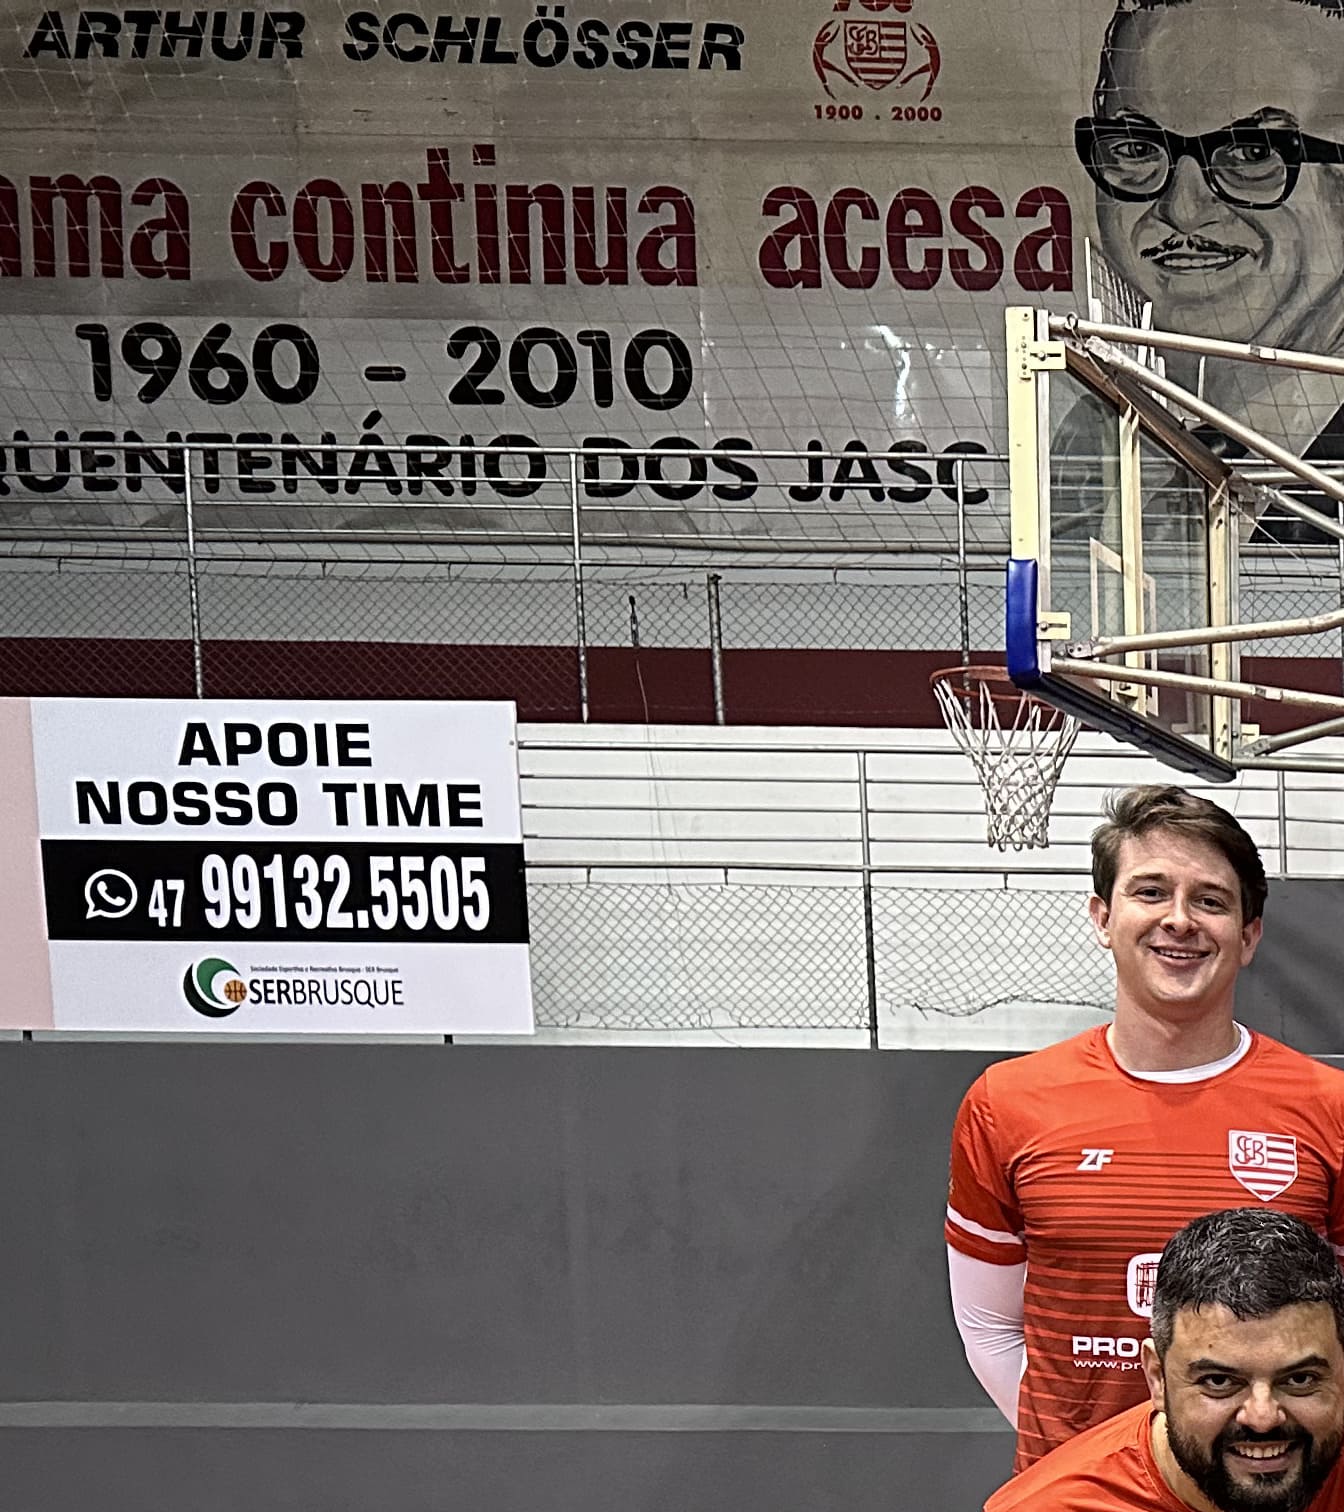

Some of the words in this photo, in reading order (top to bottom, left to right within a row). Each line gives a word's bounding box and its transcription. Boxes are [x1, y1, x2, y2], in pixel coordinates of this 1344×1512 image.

[23, 10, 305, 60] ARTHUR
[343, 5, 746, 72] SCHLÖSSER
[814, 105, 863, 120] 1900
[892, 106, 942, 121] 2000
[230, 144, 699, 287] continua
[758, 186, 1073, 292] acesa
[75, 322, 319, 405] 1960
[448, 326, 693, 410] 2010
[0, 411, 547, 499] UENTENÁRIO
[583, 437, 758, 502] DOS
[789, 439, 989, 503] JASC
[178, 722, 372, 767] APOIE
[76, 780, 299, 826] NOSSO
[322, 783, 483, 827] TIME
[149, 879, 184, 928] 47
[202, 853, 490, 931] 99132.5505
[1076, 1149, 1114, 1171] ZF
[1072, 1335, 1139, 1358] PRO
